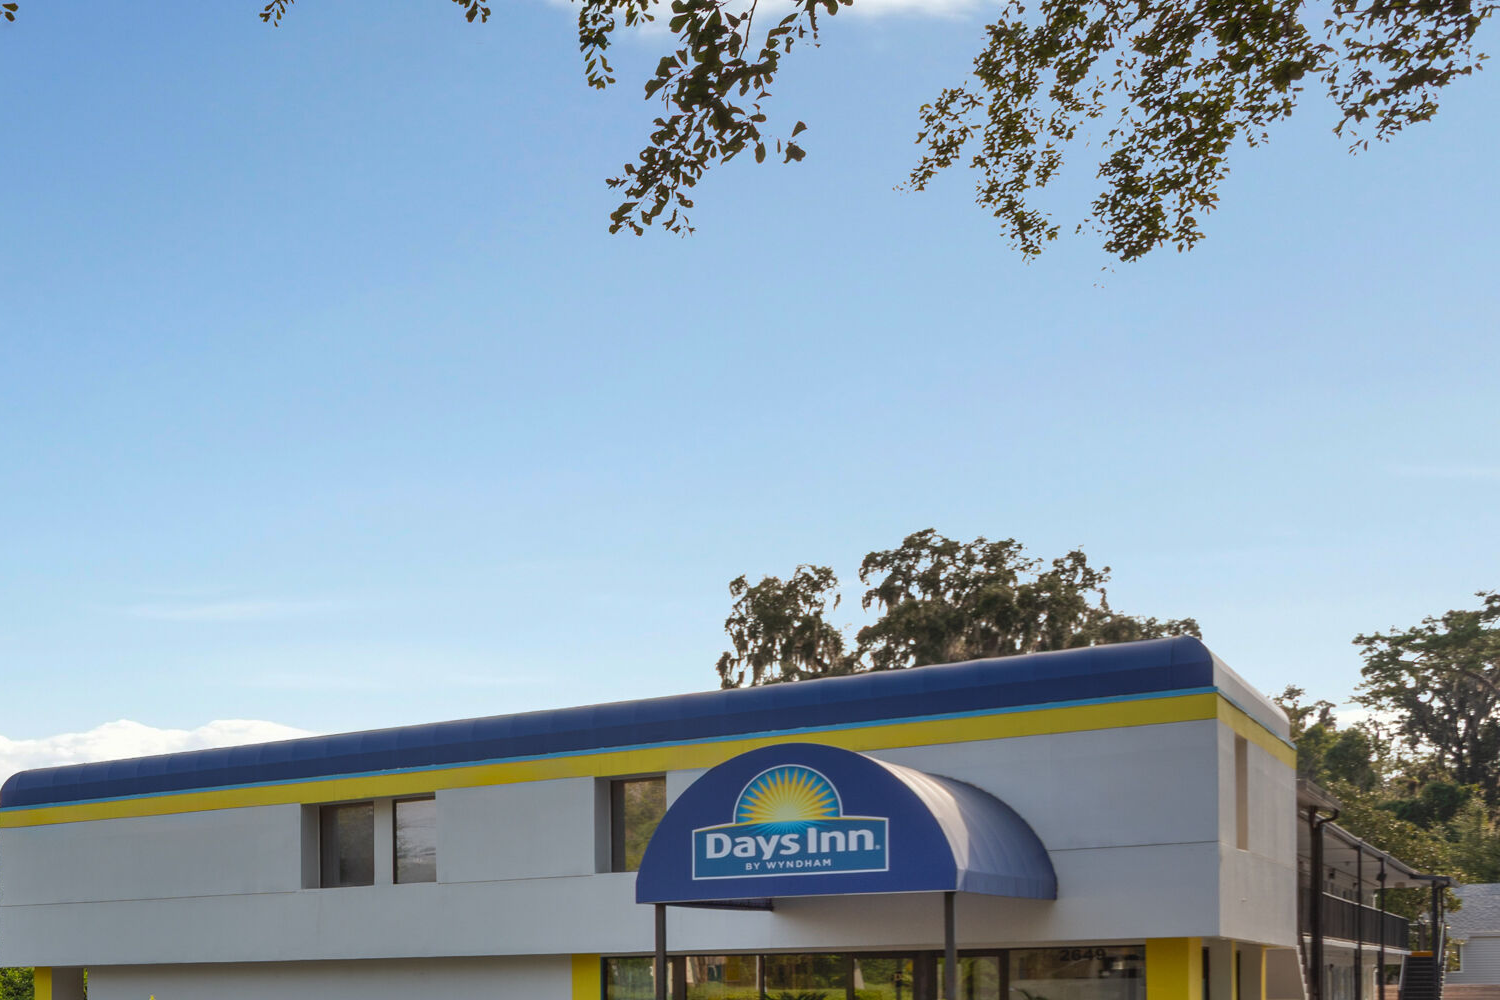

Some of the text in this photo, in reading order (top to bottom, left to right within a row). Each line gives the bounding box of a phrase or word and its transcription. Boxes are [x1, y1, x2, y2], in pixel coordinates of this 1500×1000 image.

[706, 827, 875, 860] Days Inn
[745, 858, 832, 871] BY WYNDHAM
[1060, 948, 1106, 961] 2649
